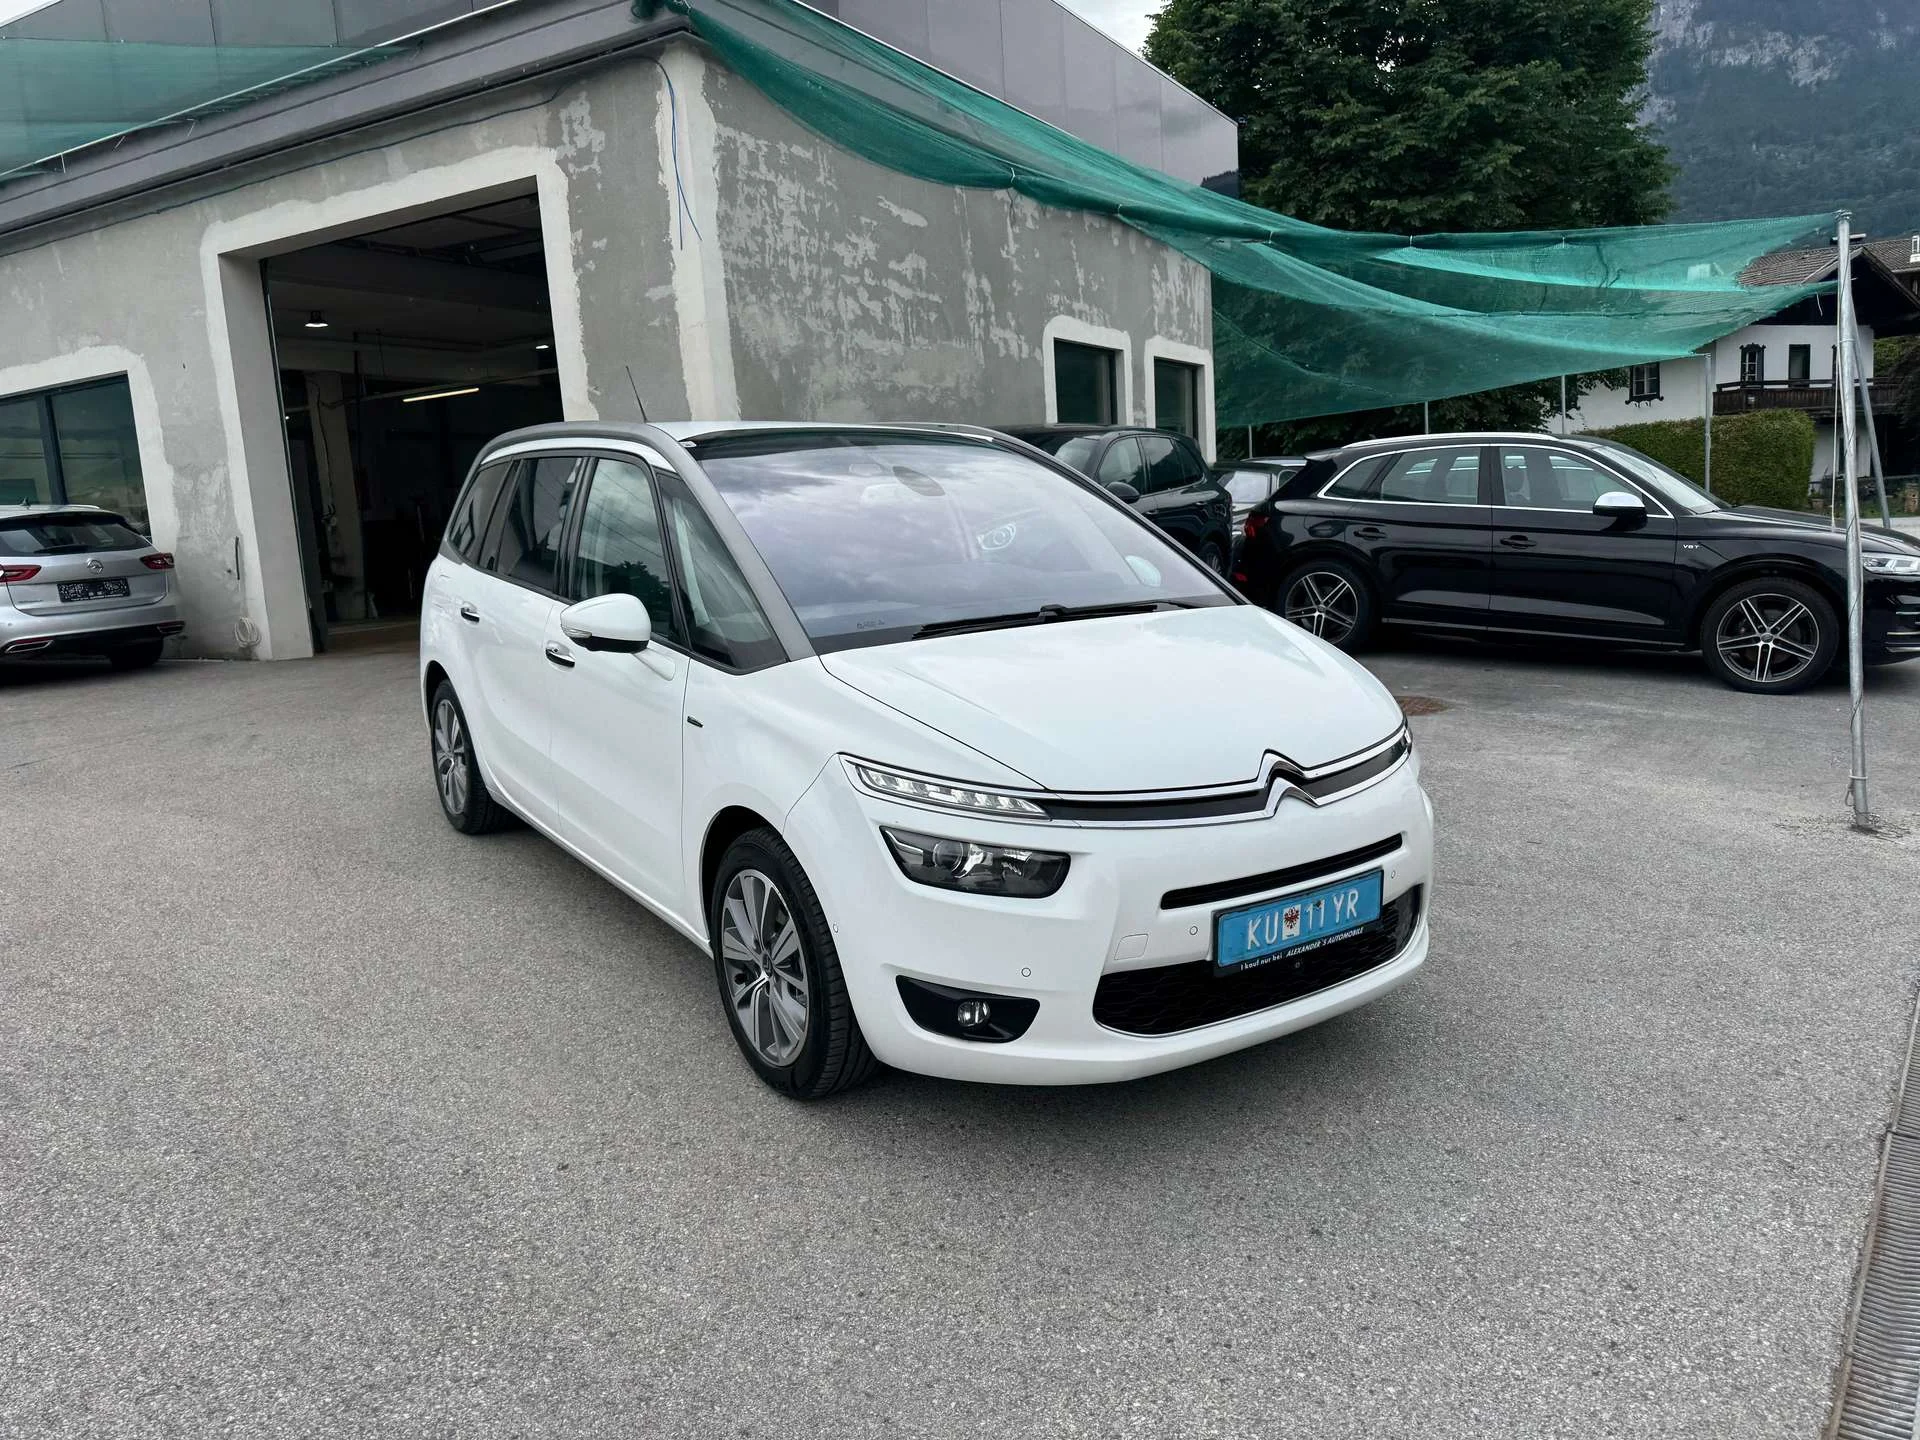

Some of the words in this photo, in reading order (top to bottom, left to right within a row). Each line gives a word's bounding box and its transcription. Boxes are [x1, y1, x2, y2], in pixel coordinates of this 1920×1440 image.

[1247, 912, 1279, 950] KU
[1306, 899, 1326, 930] 11
[1333, 888, 1359, 923] YR
[1327, 926, 1364, 945] AUTOMOBILE
